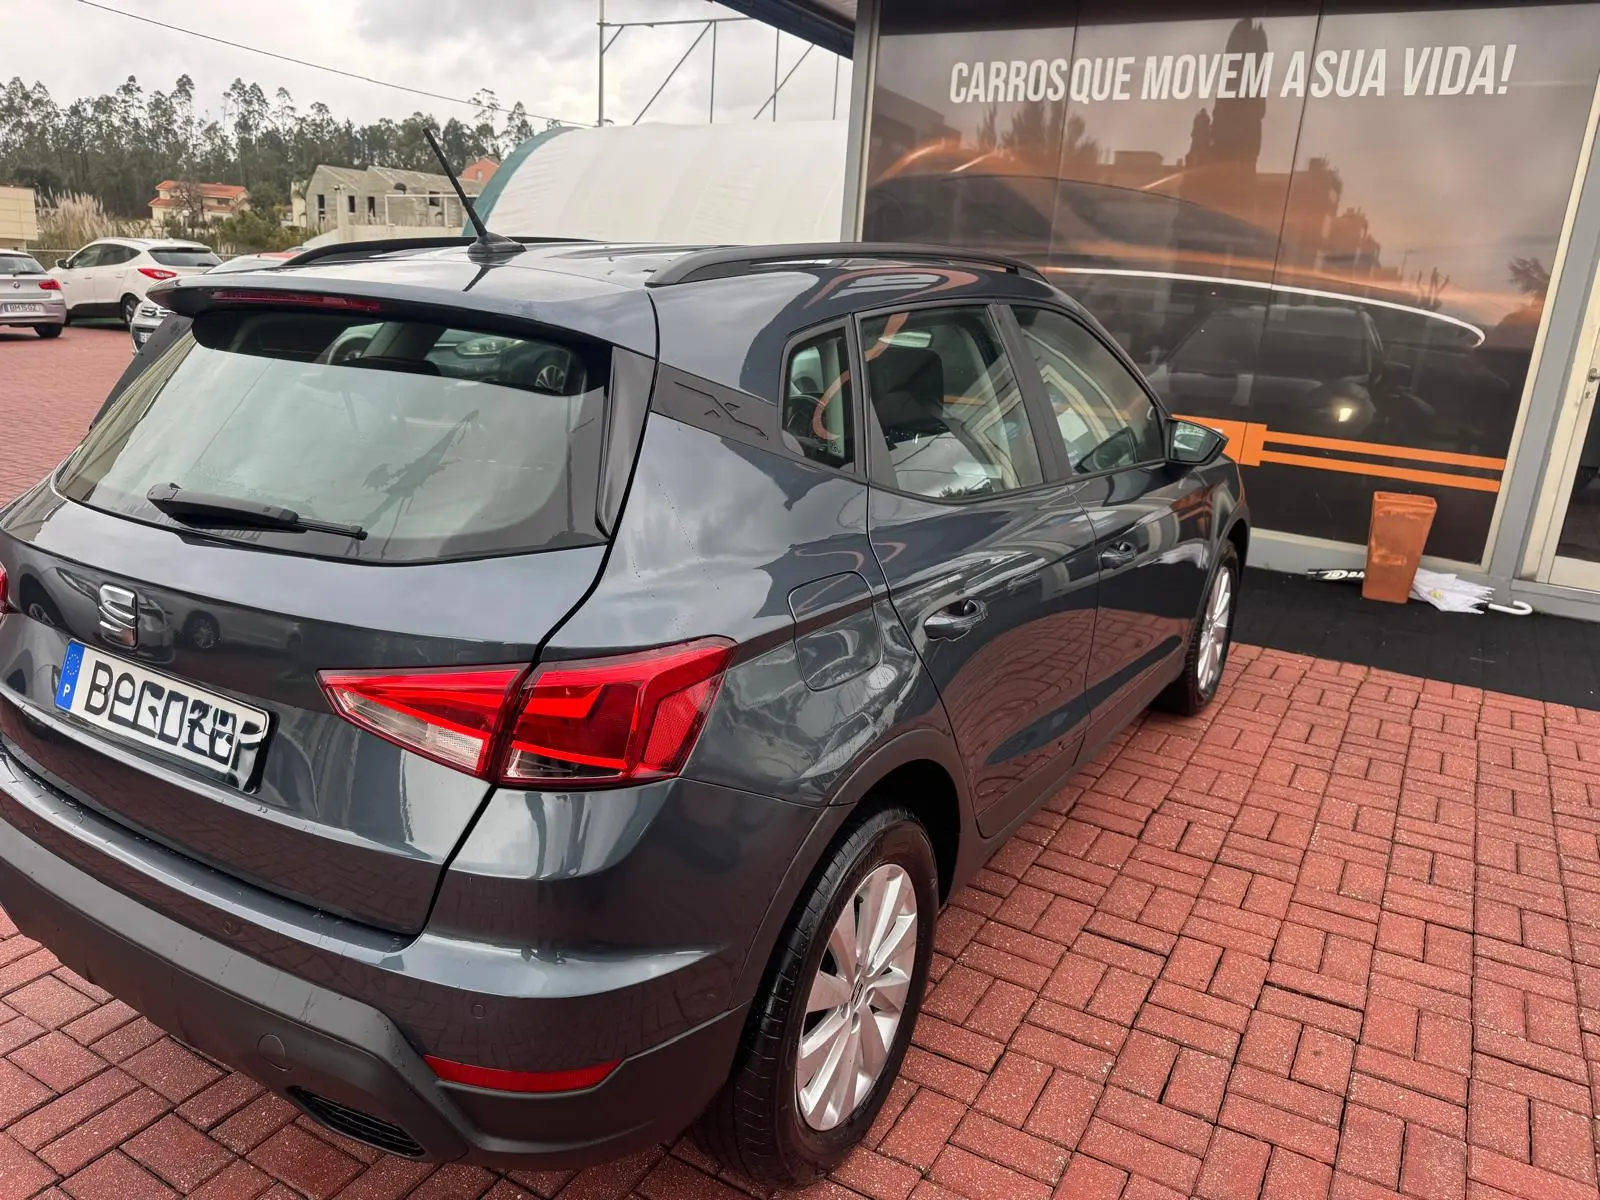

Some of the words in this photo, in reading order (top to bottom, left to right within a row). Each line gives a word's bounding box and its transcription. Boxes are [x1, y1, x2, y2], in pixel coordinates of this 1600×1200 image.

[950, 58, 1067, 104] CARROS
[1070, 57, 1135, 104] QUE
[1141, 52, 1274, 100] MOVEM
[1280, 51, 1305, 97] A
[1310, 49, 1386, 98] SUA
[1403, 44, 1517, 96] VIDA!
[62, 683, 71, 697] P
